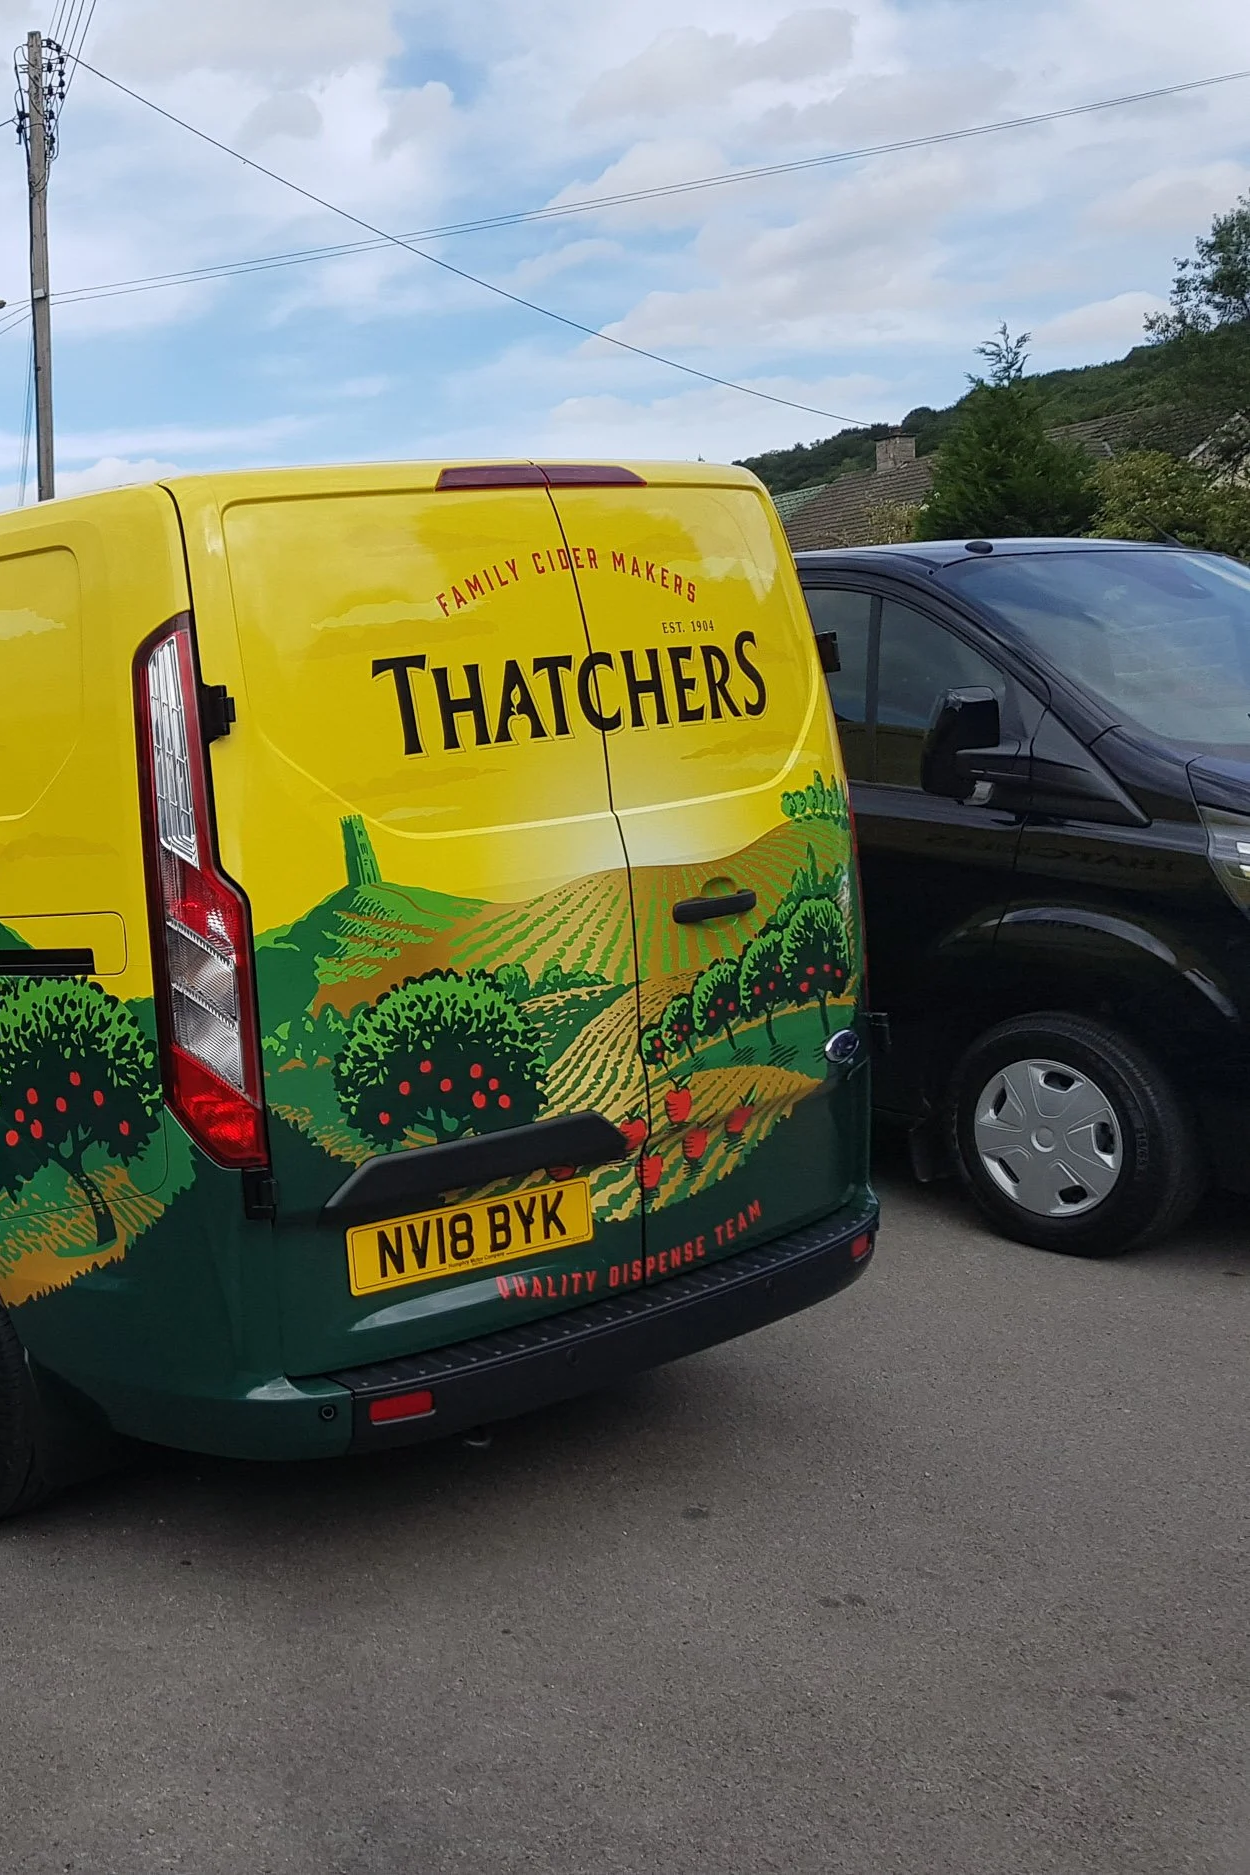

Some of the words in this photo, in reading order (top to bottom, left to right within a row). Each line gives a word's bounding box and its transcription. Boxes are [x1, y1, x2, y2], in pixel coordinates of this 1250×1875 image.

[436, 558, 520, 617] FAMILY
[531, 547, 599, 575] CIDER
[612, 550, 697, 604] MAKERS
[662, 621, 686, 635] EST.
[691, 619, 714, 633] 1904
[371, 630, 768, 758] THATCHERS
[377, 1213, 475, 1278] NV18
[488, 1191, 567, 1253] BYK
[495, 1271, 598, 1300] QUALITY
[608, 1235, 706, 1288] DISPENSE
[714, 1199, 762, 1247] TEAM
